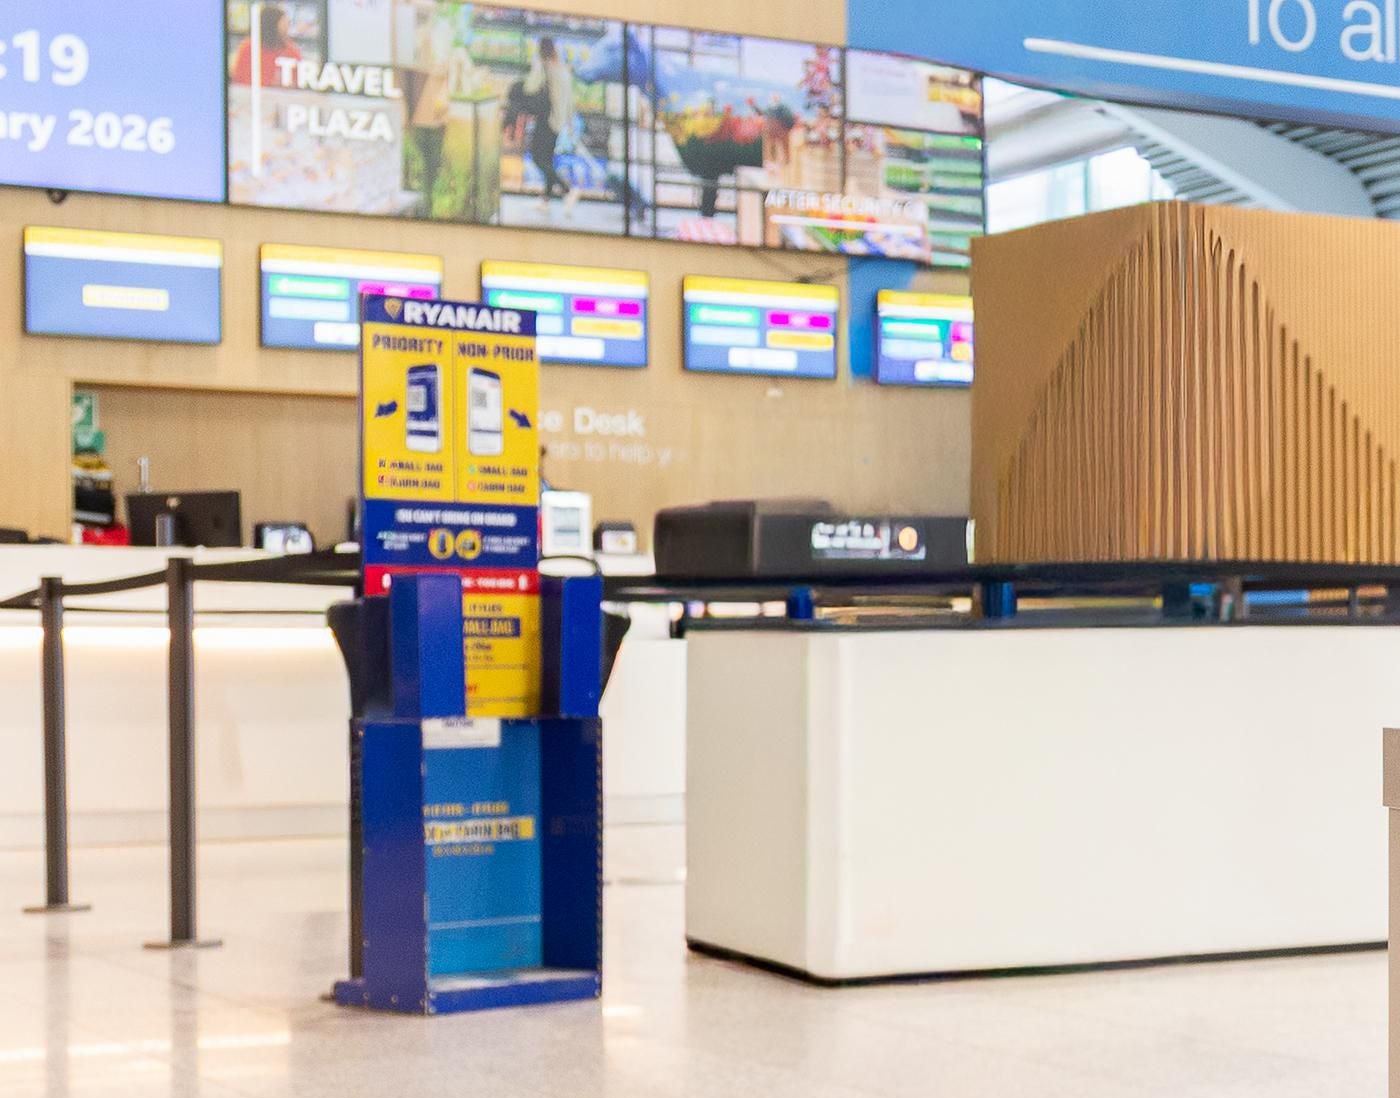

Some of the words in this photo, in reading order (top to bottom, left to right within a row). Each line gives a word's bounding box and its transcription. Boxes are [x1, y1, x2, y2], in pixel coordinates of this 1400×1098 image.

[274, 56, 402, 99] TRAVEL
[66, 107, 176, 154] 2026
[287, 104, 395, 142] PLAZA
[403, 300, 522, 334] RYANAIR
[372, 334, 444, 355] PRIORITY
[573, 406, 645, 437] Desk
